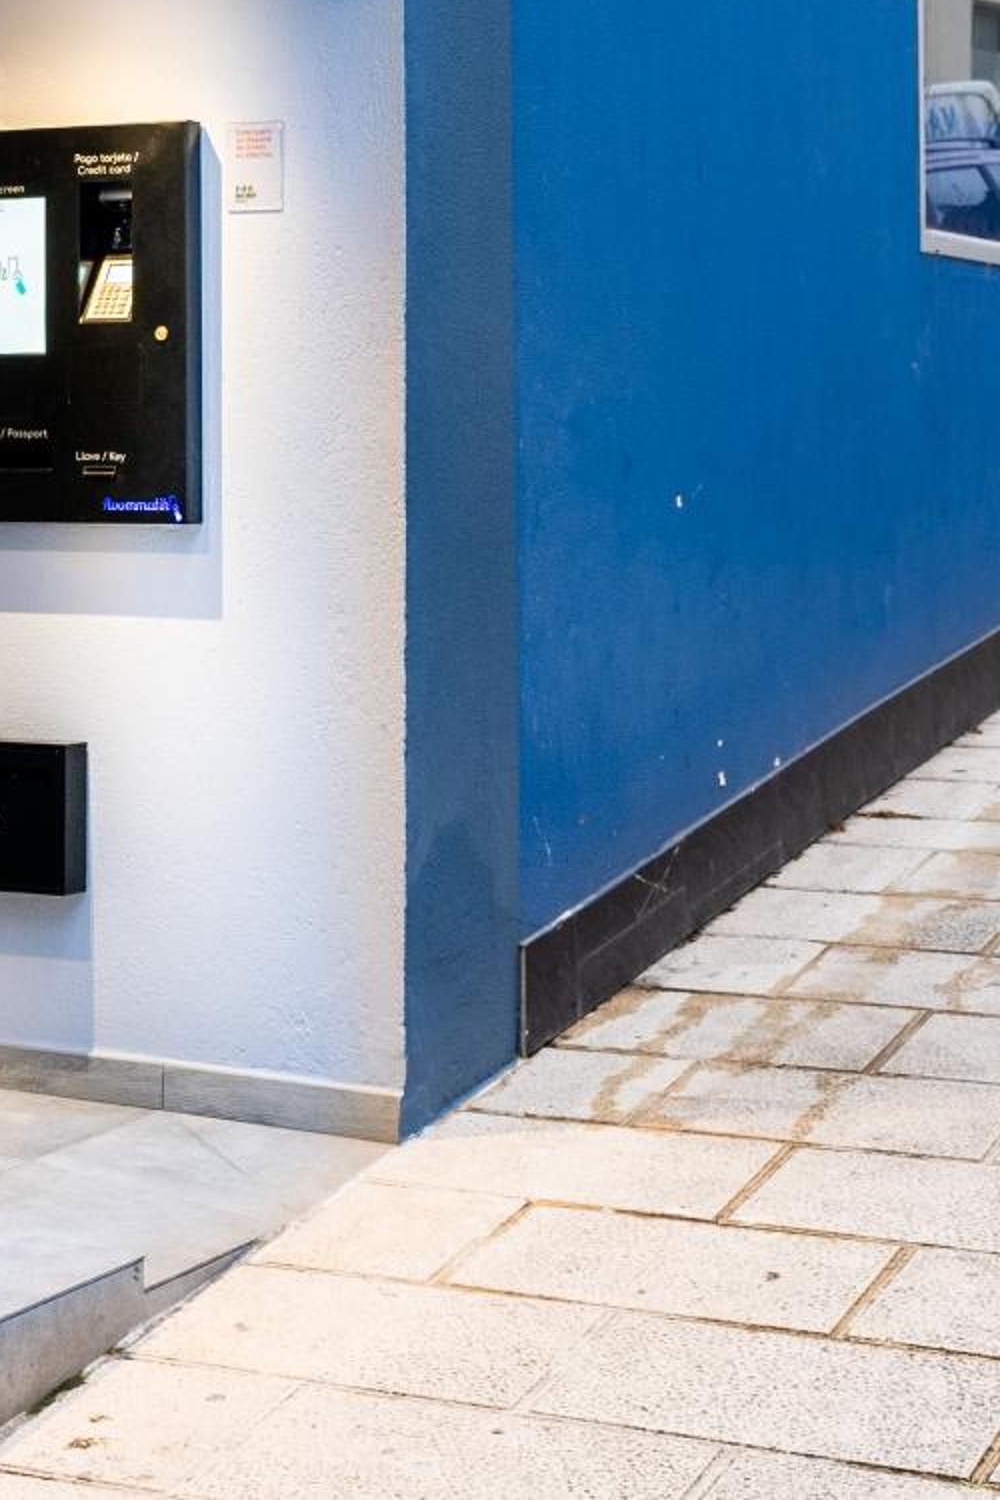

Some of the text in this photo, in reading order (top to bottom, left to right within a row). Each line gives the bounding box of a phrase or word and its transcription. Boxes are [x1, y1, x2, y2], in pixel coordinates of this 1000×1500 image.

[73, 153, 99, 165] Pago
[99, 152, 133, 165] tarjeta
[77, 164, 132, 175] Credit card
[7, 427, 49, 440] Passport
[75, 451, 101, 461] Llave
[108, 451, 127, 463] Key
